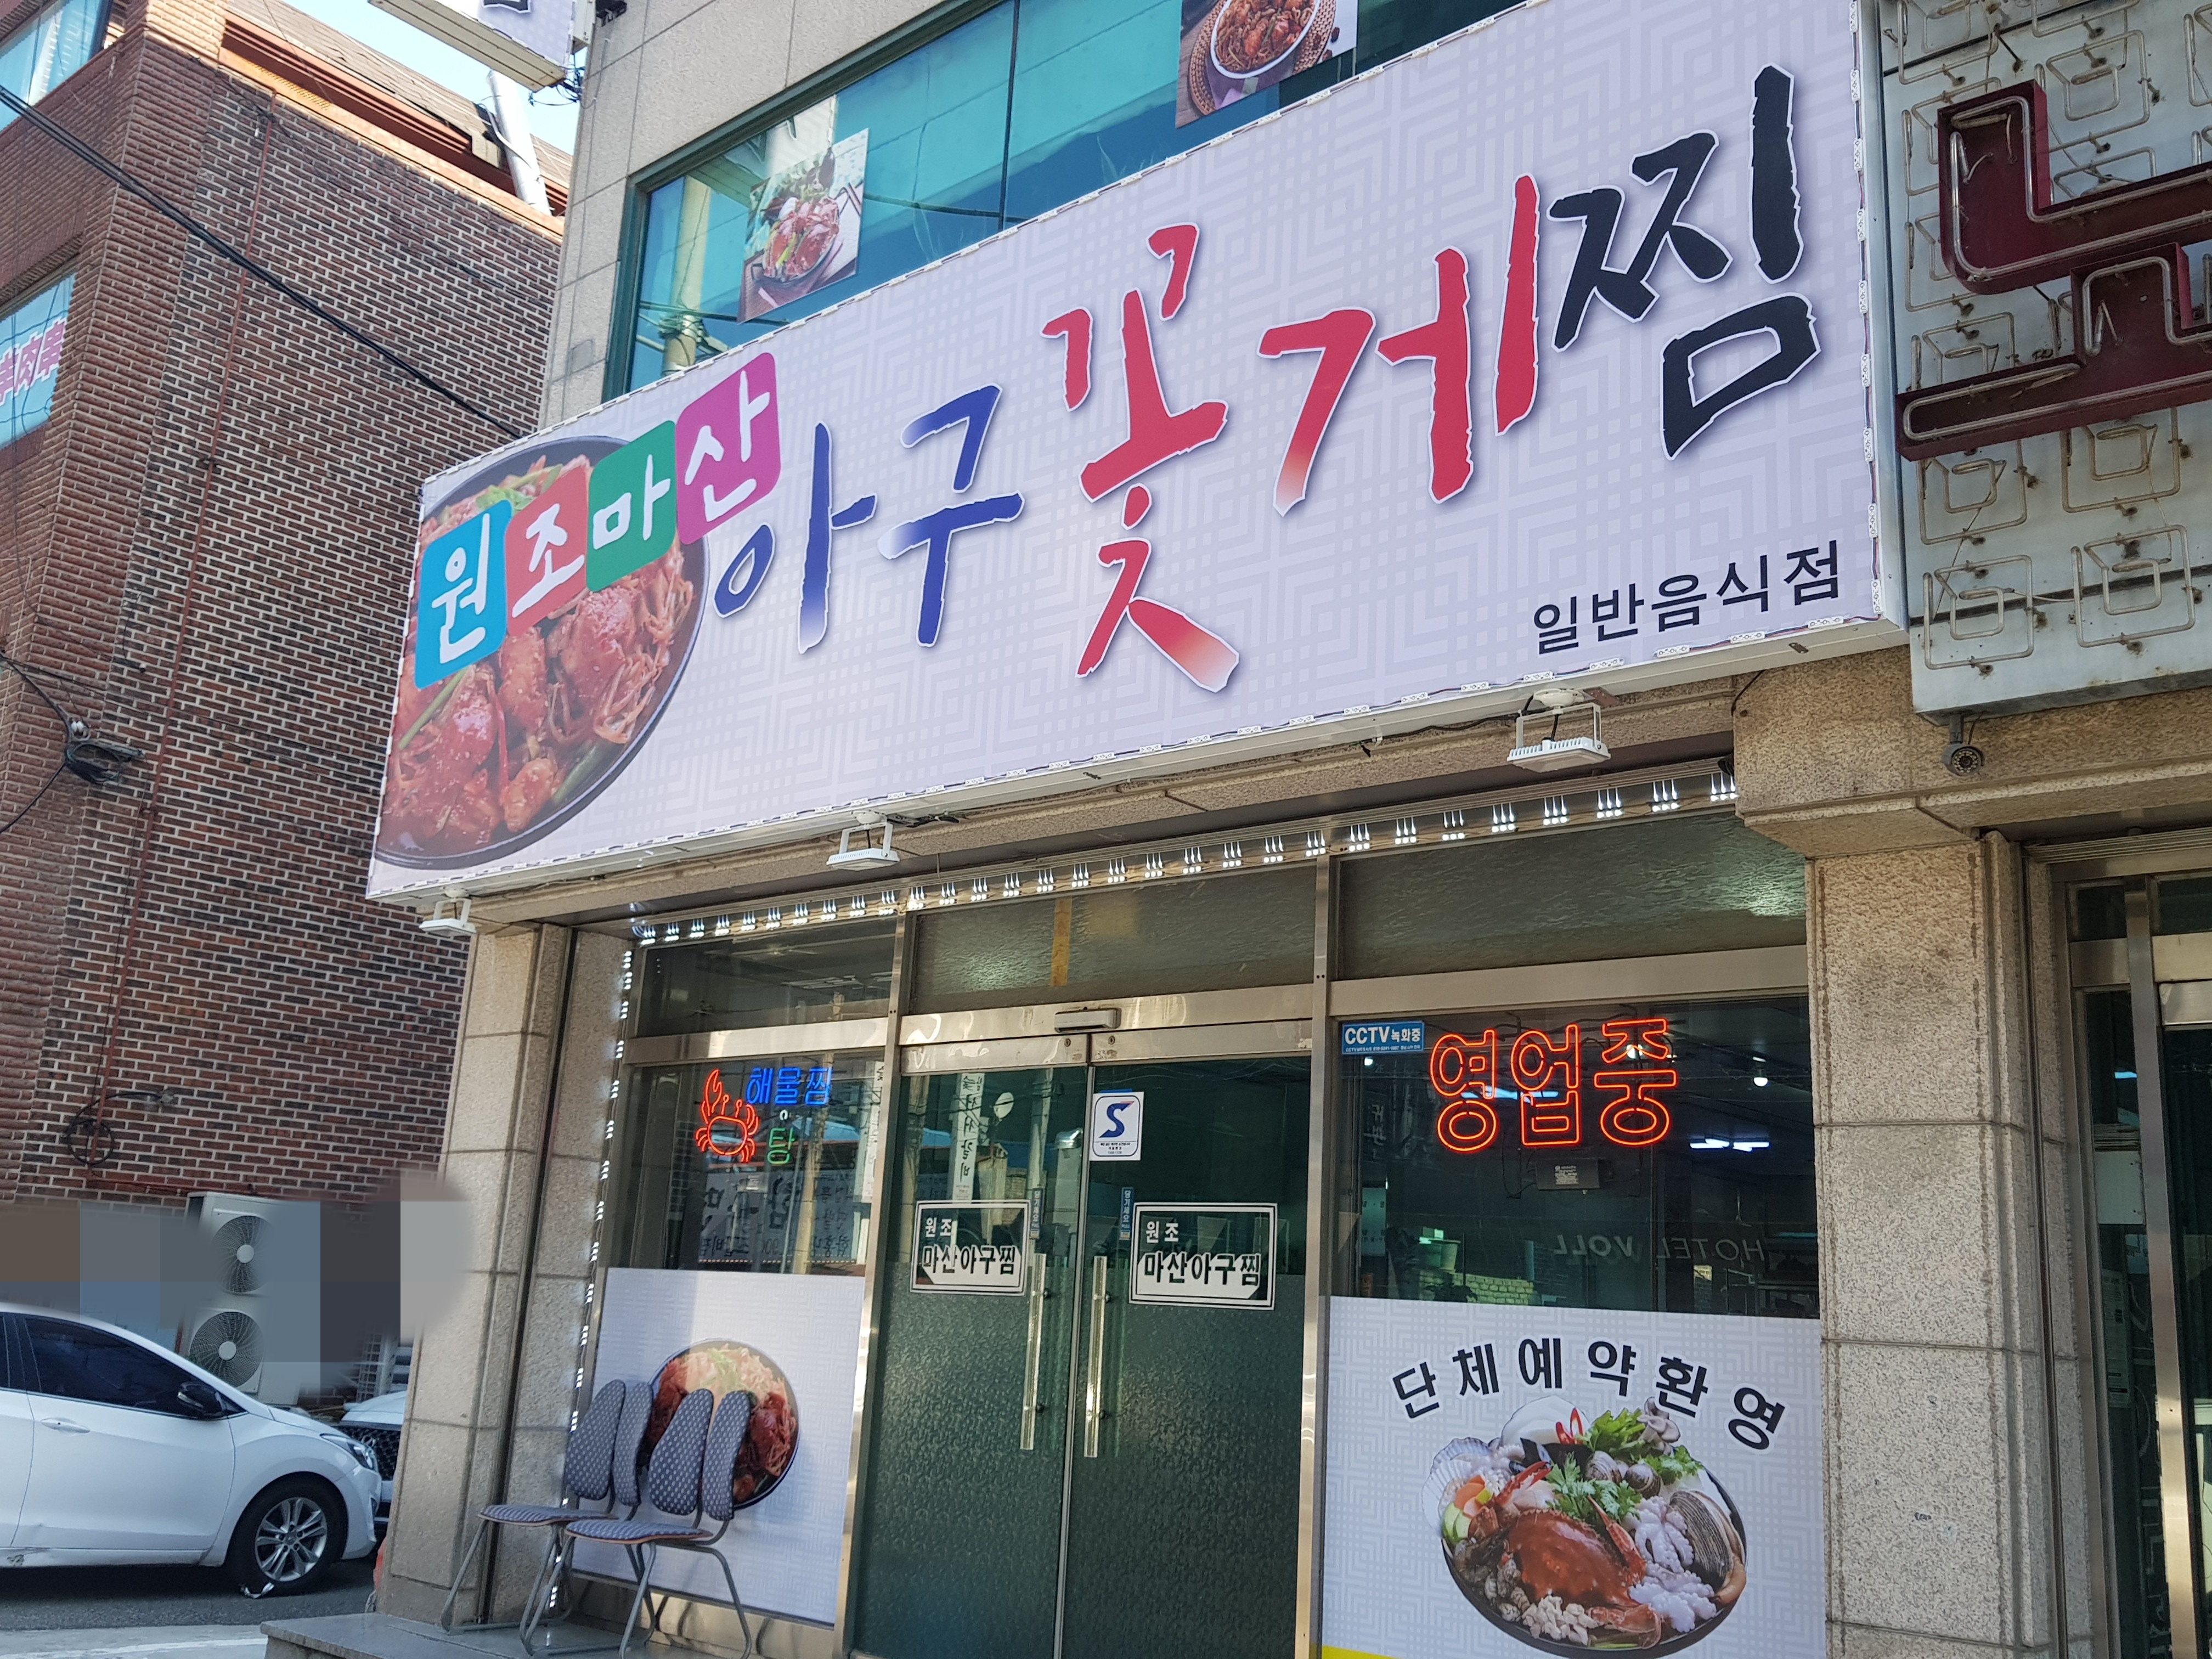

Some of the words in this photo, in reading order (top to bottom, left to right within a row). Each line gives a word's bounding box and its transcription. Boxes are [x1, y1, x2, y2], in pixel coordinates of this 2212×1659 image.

[1533, 539, 1838, 655] 일반음식점
[1345, 1026, 1390, 1045] CCTV
[1391, 1028, 1420, 1042] 녹화중
[746, 1066, 833, 1105] 해물찜
[1430, 1018, 1677, 1152] 영업중
[767, 1127, 795, 1166] 탕
[925, 1217, 952, 1238] 원조
[1146, 1221, 1179, 1244] 원조
[923, 1244, 1016, 1275] 마산아구찜
[1144, 1252, 1260, 1286] 마산아구찜
